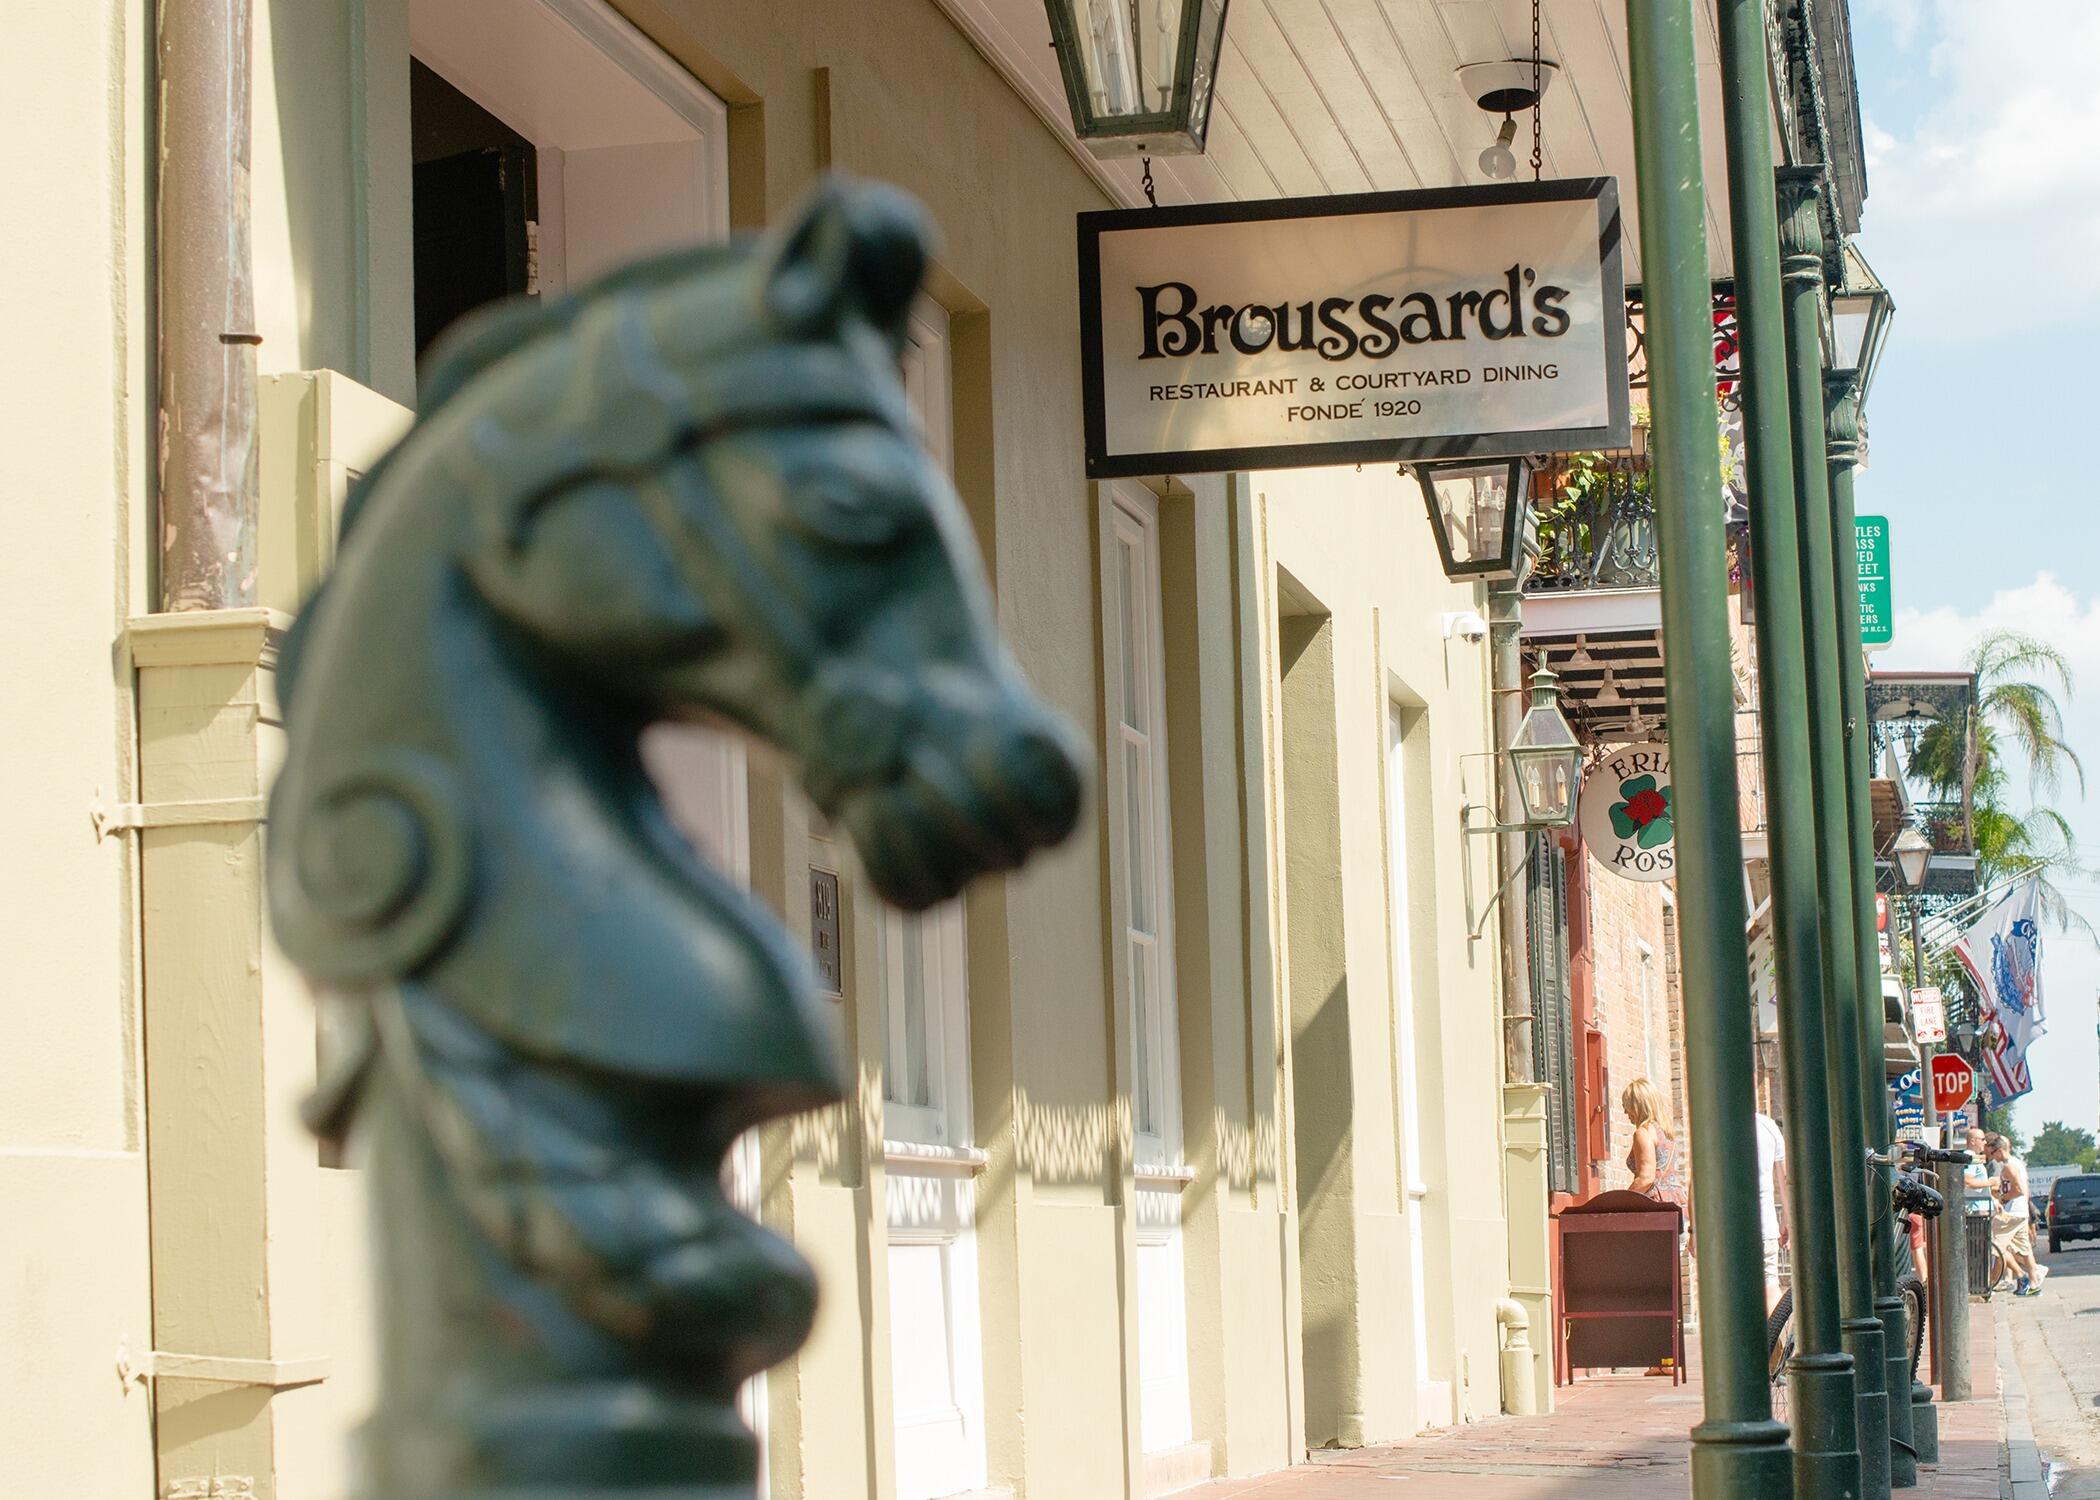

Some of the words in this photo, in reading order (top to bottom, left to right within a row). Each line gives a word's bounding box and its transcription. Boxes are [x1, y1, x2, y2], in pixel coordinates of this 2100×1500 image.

[1135, 263, 1570, 361] Broussard's
[1149, 378, 1298, 401] RESTAURANT
[1309, 377, 1326, 393] &
[1335, 369, 1471, 391] COURTYARD
[1483, 364, 1558, 383] DINING
[1374, 399, 1422, 417] 1920
[1609, 752, 1671, 782] ERI
[1611, 845, 1674, 872] ROS
[816, 879, 832, 921] 819
